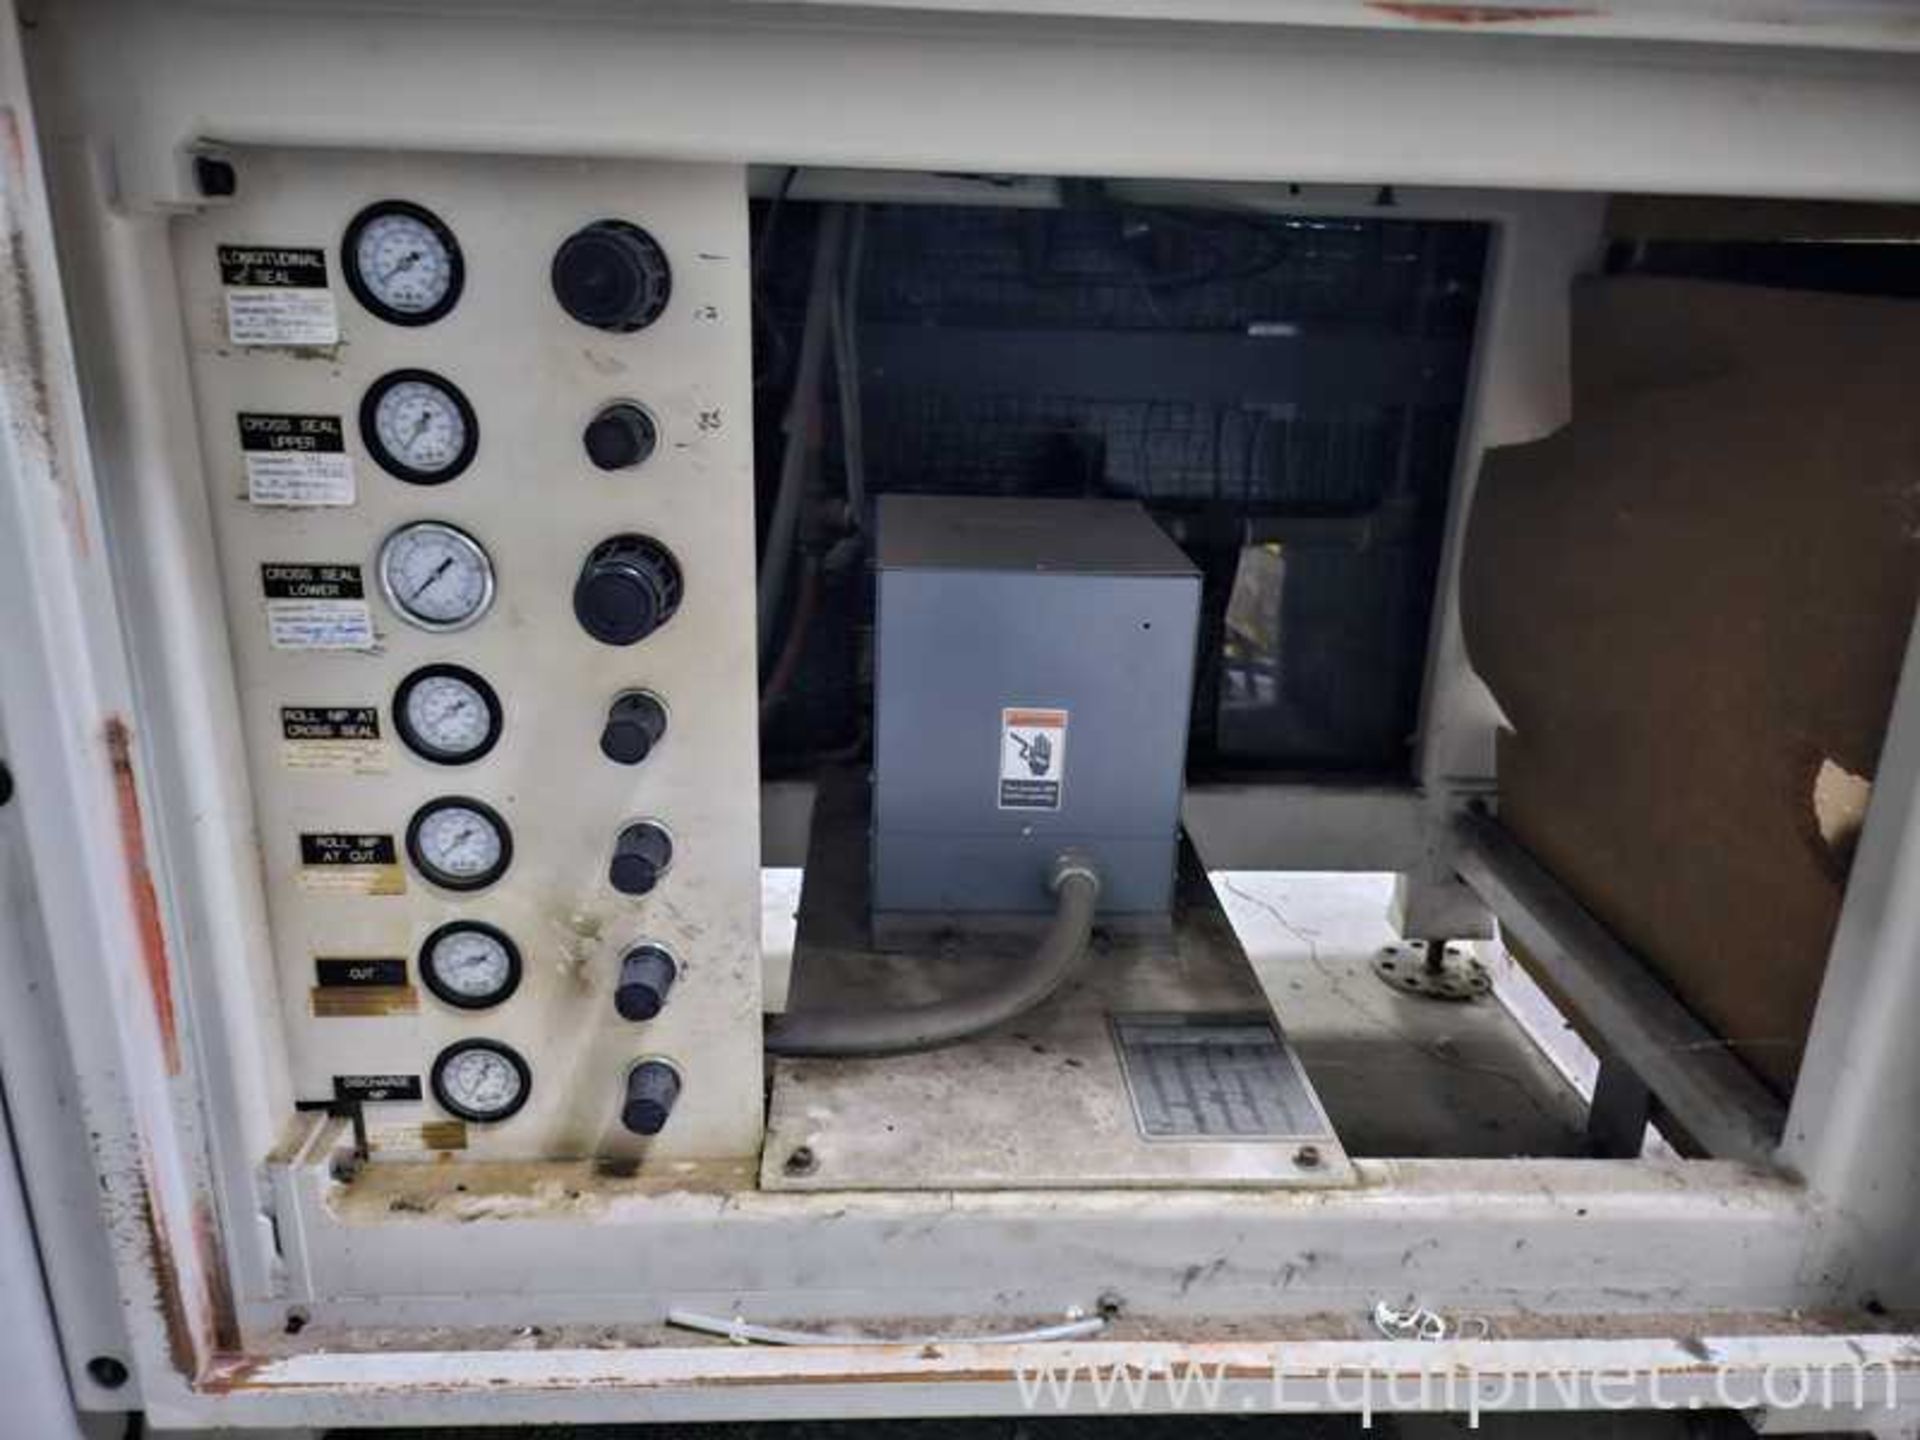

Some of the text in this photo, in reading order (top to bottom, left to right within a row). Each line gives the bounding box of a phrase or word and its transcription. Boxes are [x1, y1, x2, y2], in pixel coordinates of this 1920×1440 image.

[244, 417, 340, 436] CROSS SEAL
[269, 434, 317, 451] UPPER
[265, 567, 361, 582] CROSS SEAL
[287, 582, 341, 597] LOWER
[356, 709, 377, 724] AT
